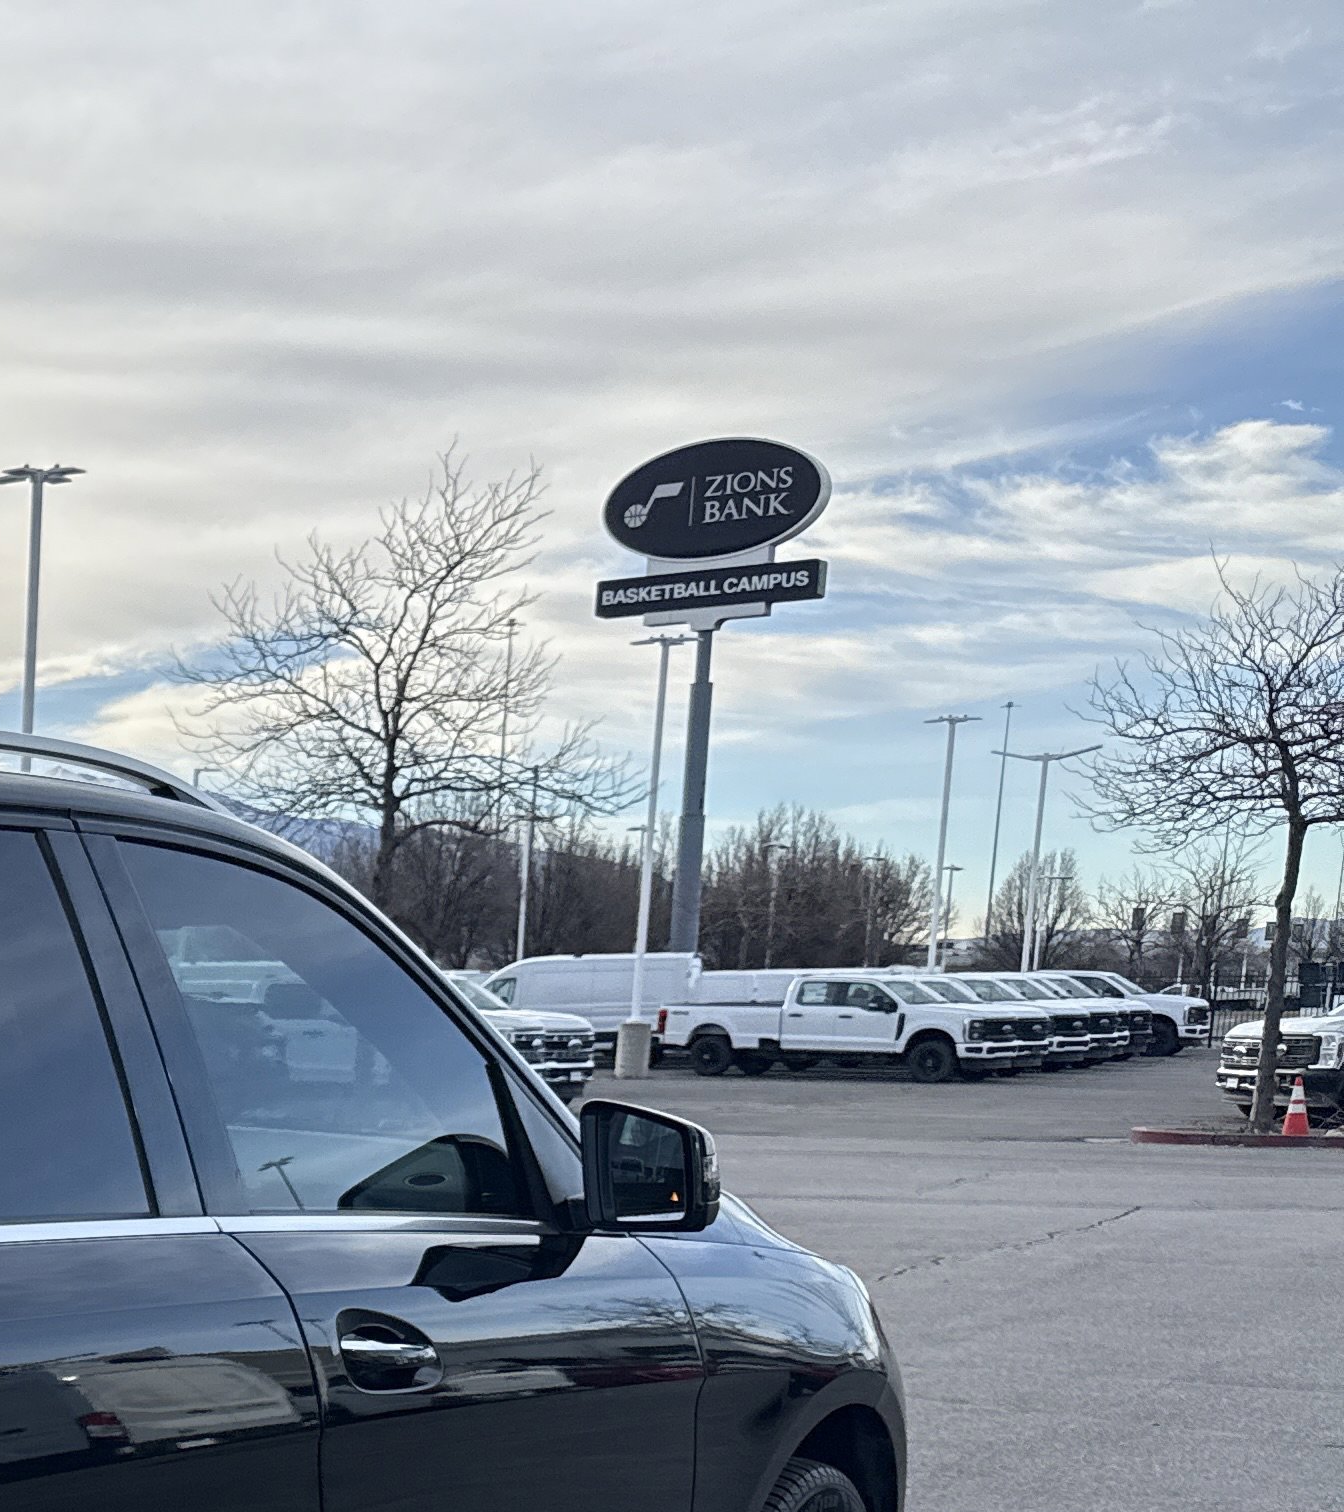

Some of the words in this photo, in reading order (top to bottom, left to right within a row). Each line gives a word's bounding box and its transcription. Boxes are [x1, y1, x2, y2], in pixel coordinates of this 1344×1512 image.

[703, 466, 793, 497] ZIONS
[701, 492, 792, 524] BANK
[601, 578, 721, 606] BASKETBALL
[722, 570, 810, 594] CAMPUS
